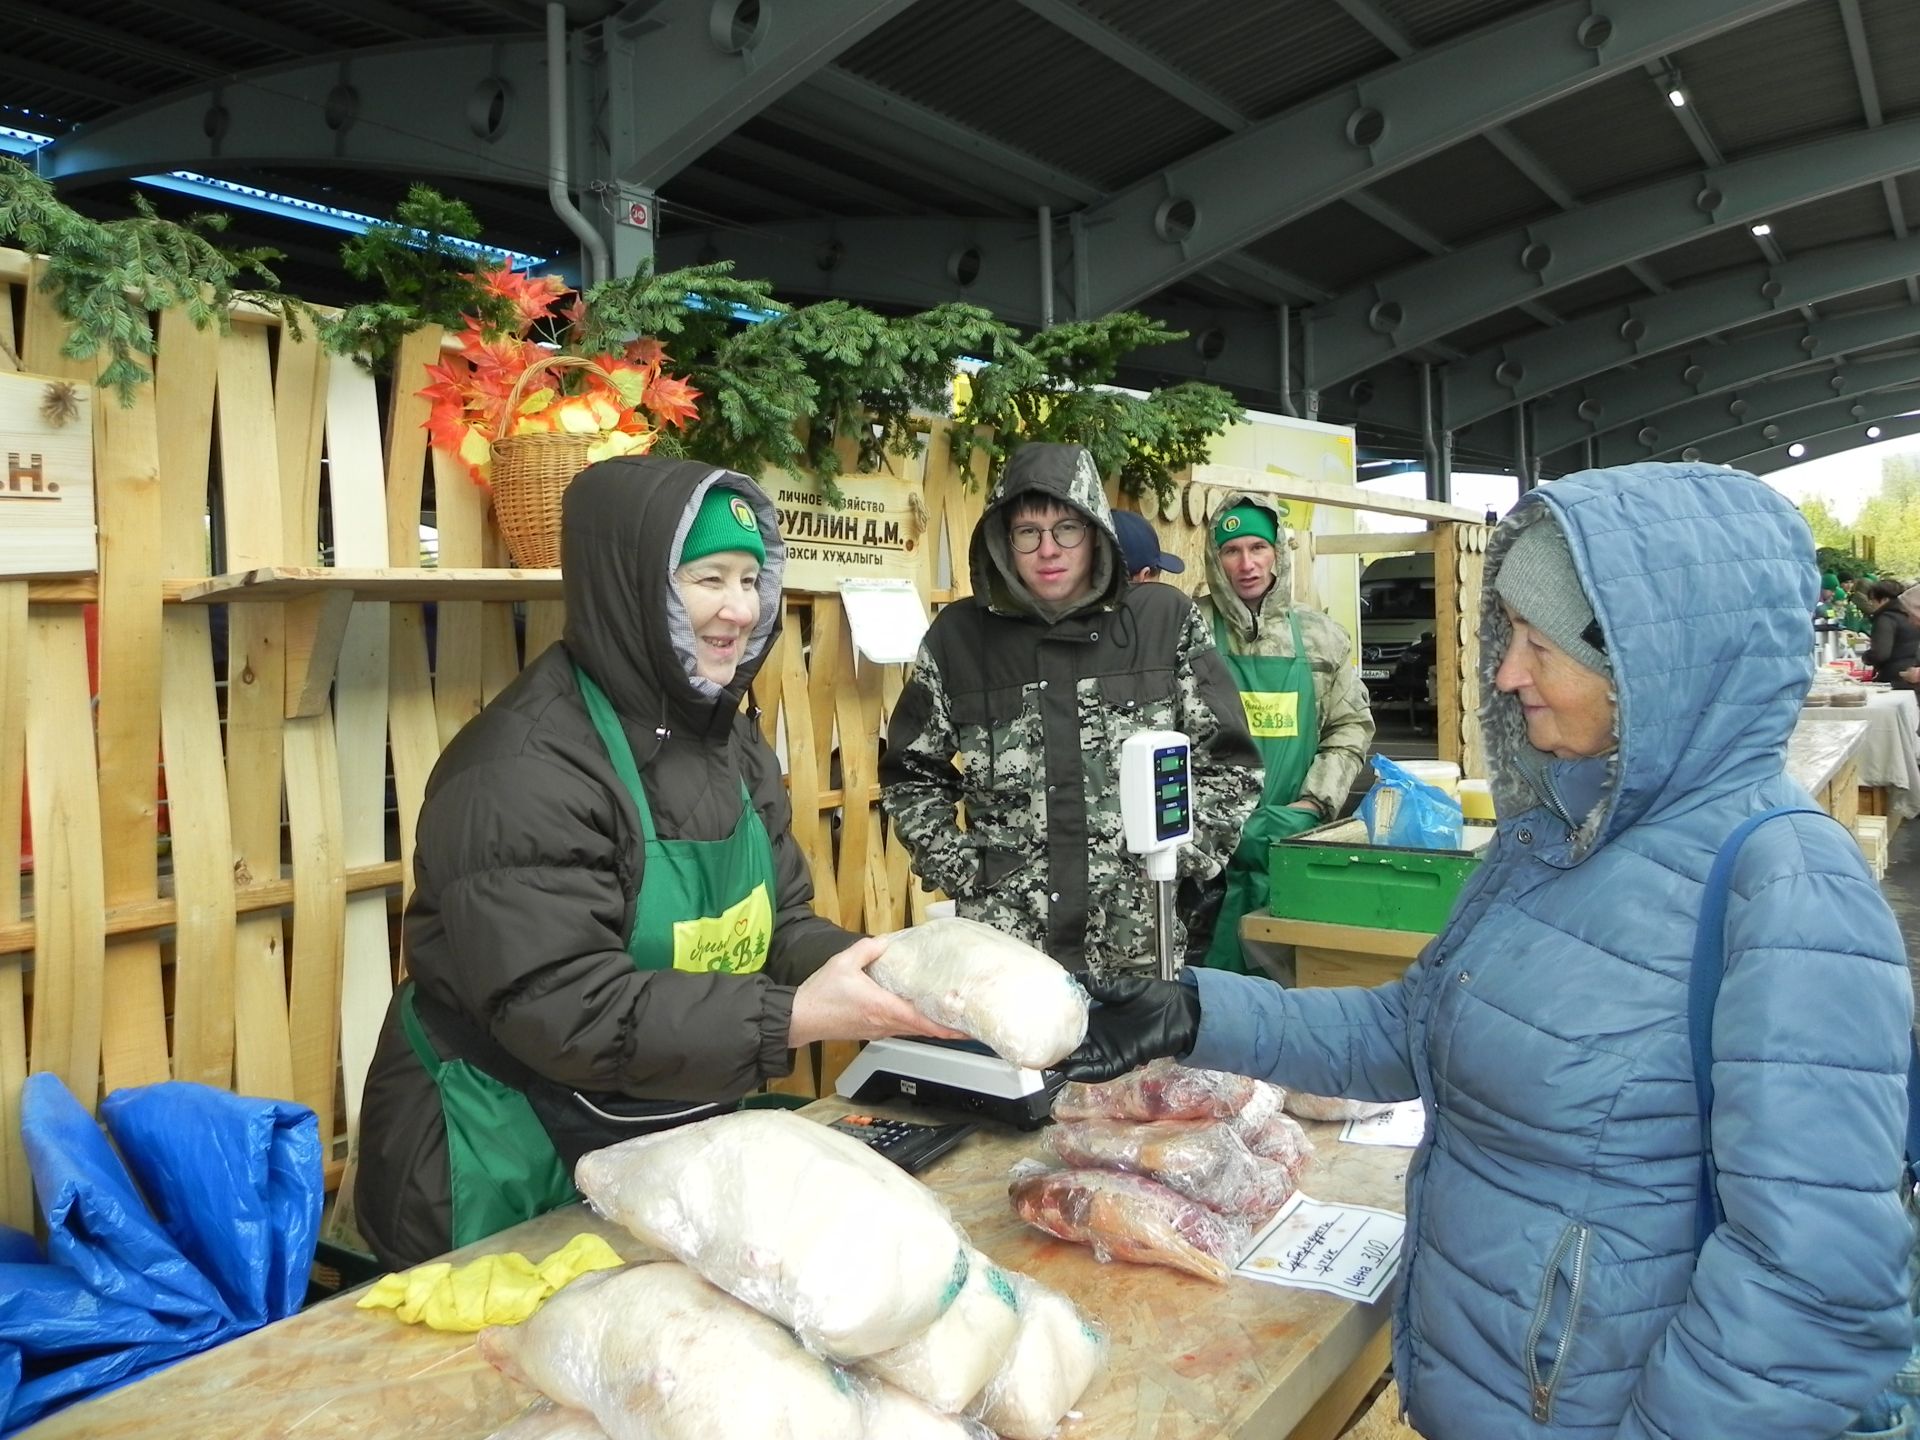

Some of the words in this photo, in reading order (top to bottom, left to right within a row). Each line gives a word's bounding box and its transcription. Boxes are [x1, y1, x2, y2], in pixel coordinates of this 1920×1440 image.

[778, 489, 822, 506] ЛИЧНОЕ
[827, 496, 885, 513] ЗЯЙСТВО
[862, 518, 904, 546] Д.М.
[785, 546, 818, 561] ӘХСИ
[822, 549, 883, 565] ХУҖАЛЫГЫ
[1344, 1264, 1372, 1287] Цена
[1361, 1239, 1389, 1264] 300
